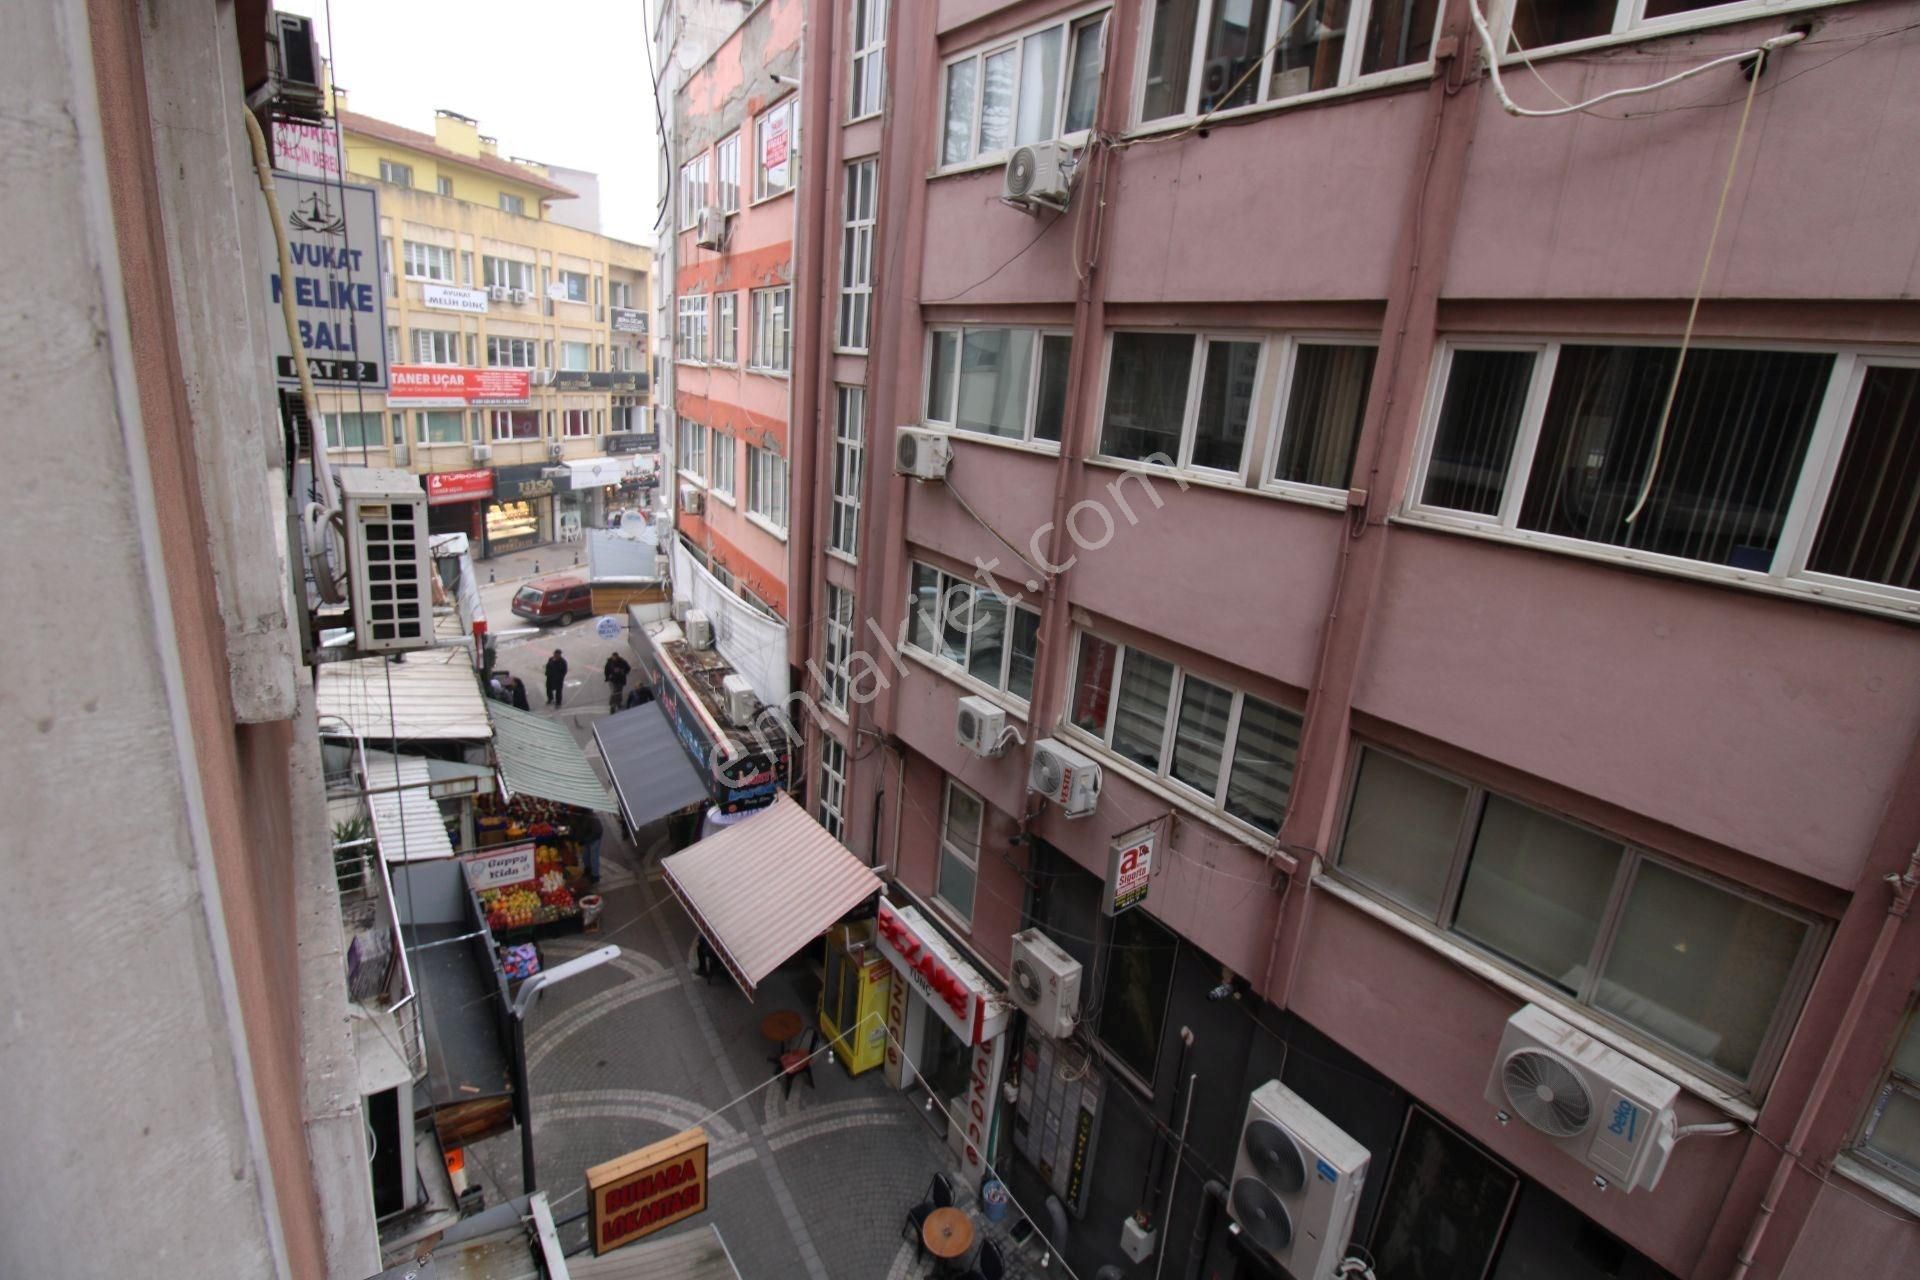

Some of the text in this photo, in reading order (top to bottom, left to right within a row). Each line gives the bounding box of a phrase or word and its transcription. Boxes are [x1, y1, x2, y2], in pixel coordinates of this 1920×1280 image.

[278, 242, 362, 271] VUKAT
[391, 373, 432, 385] TANER
[432, 374, 464, 388] UÇAR
[1060, 768, 1072, 803] VESTEL
[910, 967, 931, 997] TUNÇ
[1608, 1100, 1632, 1136] beko
[605, 1158, 697, 1216] BUHARA
[602, 1183, 700, 1245] LOKANTASI
